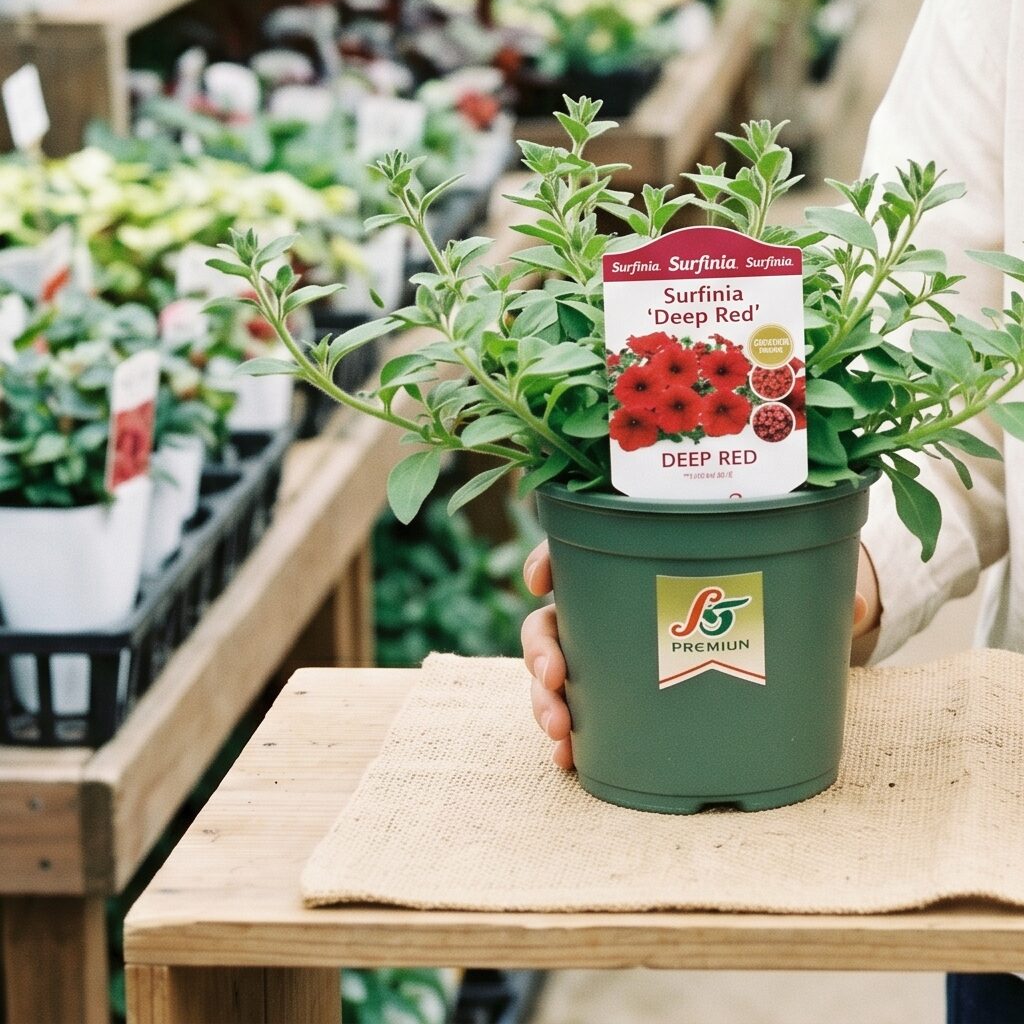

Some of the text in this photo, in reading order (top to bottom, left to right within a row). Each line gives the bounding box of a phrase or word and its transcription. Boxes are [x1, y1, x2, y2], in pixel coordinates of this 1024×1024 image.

[664, 285, 744, 304] Surfinia
[662, 450, 758, 468] DEEP RED
[672, 639, 750, 653] PREMIUN
